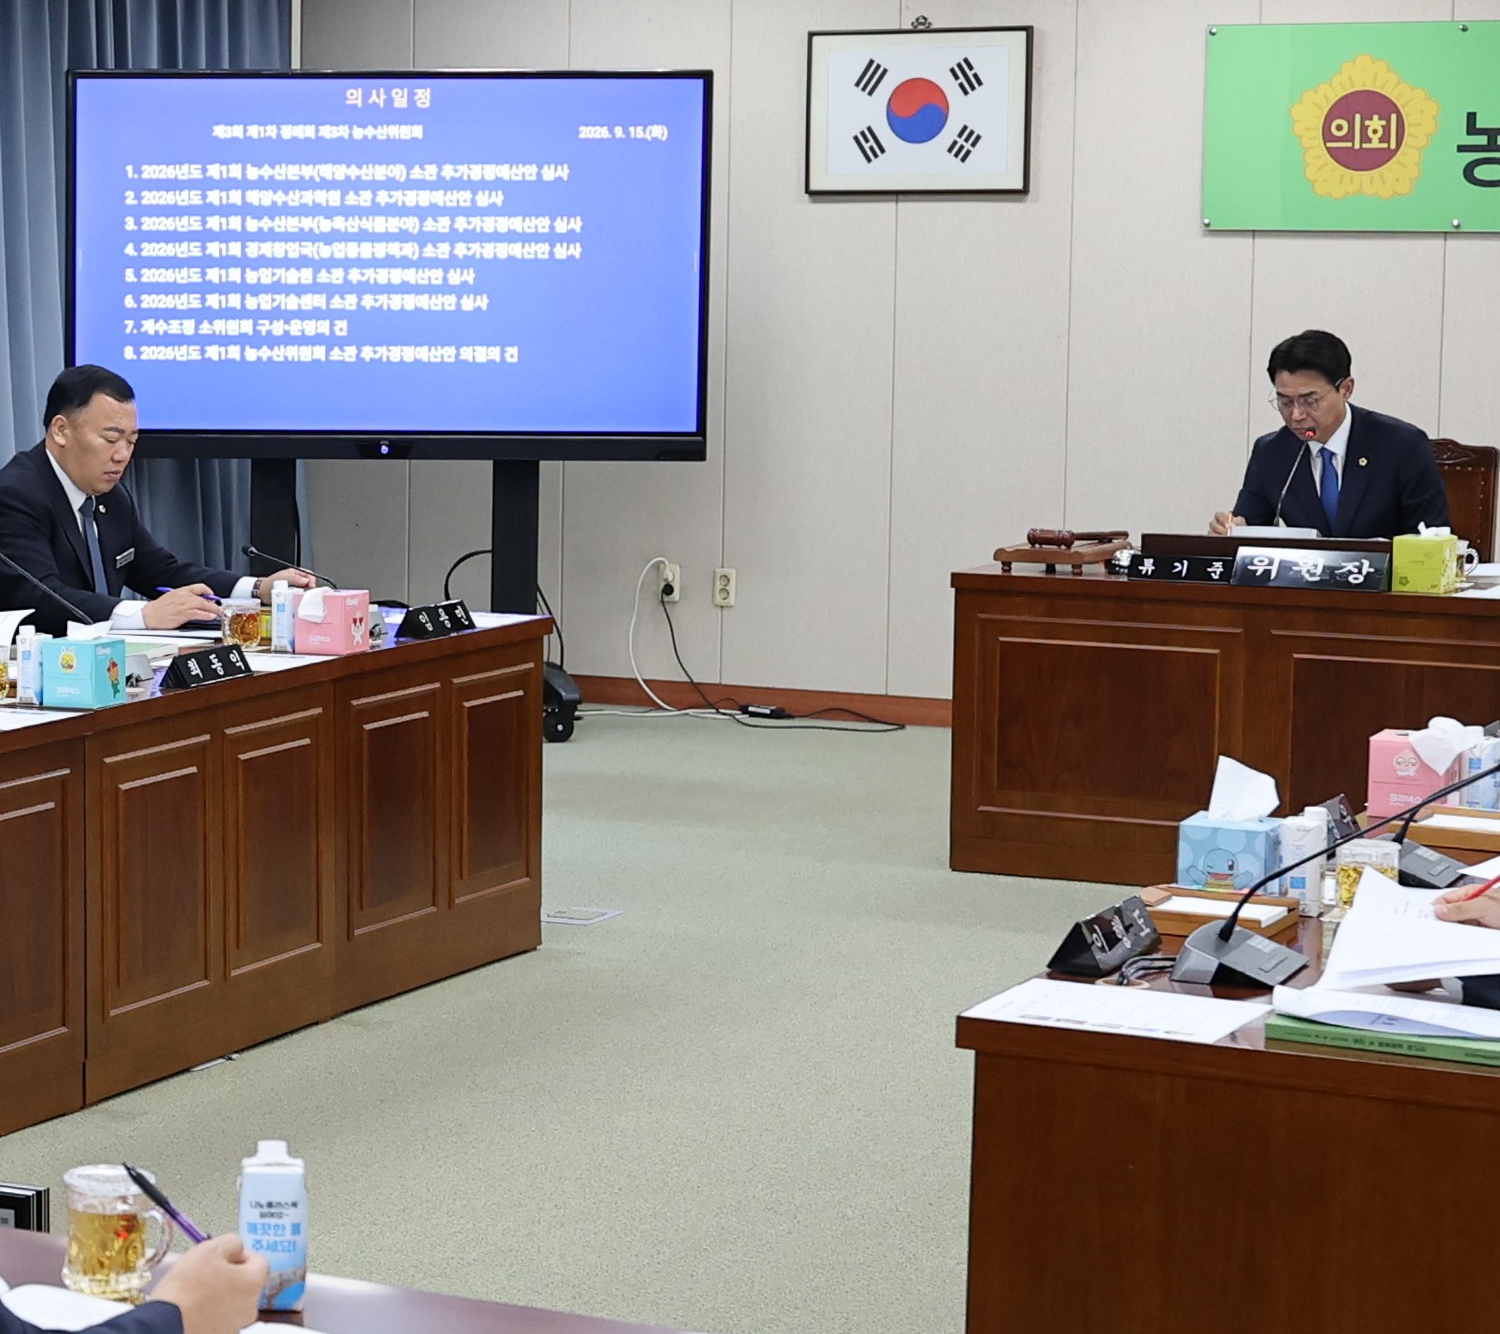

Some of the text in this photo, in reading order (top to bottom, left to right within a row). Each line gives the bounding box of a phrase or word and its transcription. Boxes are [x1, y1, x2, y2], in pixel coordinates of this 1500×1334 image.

[352, 125, 423, 142] 농수산위원회
[579, 125, 612, 142] 2026.
[614, 125, 626, 142] 9.
[1326, 113, 1399, 151] 의회
[126, 163, 138, 181] 1.
[141, 163, 203, 181] 2026년도
[206, 163, 242, 181] 제1회
[410, 163, 438, 181] 소관
[541, 163, 569, 181] 심사
[125, 190, 138, 207] 2.
[141, 190, 203, 207] 2026년도
[206, 190, 241, 207] 제1회
[344, 190, 373, 207] 소관
[475, 190, 504, 207] 심사
[125, 216, 138, 233] 3.
[141, 216, 203, 233] 2026년도
[206, 216, 241, 233] 제1회
[423, 216, 451, 233] 소관
[554, 216, 583, 233] 심사
[124, 242, 138, 259] 4.
[141, 242, 203, 259] 2026년도
[206, 242, 241, 259] 제1회
[422, 242, 451, 259] 소관
[553, 242, 582, 259] 심사
[125, 268, 137, 285] 5.
[141, 268, 202, 285] 2026년도
[205, 268, 241, 285] 제1회
[316, 268, 344, 285] 소관
[447, 268, 475, 285] 심사
[124, 294, 137, 311] 6.
[140, 294, 202, 311] 2026년도
[205, 294, 241, 311] 제1회
[330, 294, 358, 311] 소관
[460, 294, 489, 311] 심사
[124, 320, 137, 337] 7.
[334, 320, 347, 337] 건
[124, 346, 137, 363] 8.
[140, 346, 202, 363] 2026년도
[205, 346, 241, 363] 제1회
[244, 346, 326, 363] 농수산위원회
[329, 346, 358, 363] 소관
[504, 346, 518, 363] 건
[1248, 556, 1375, 584] 위원장
